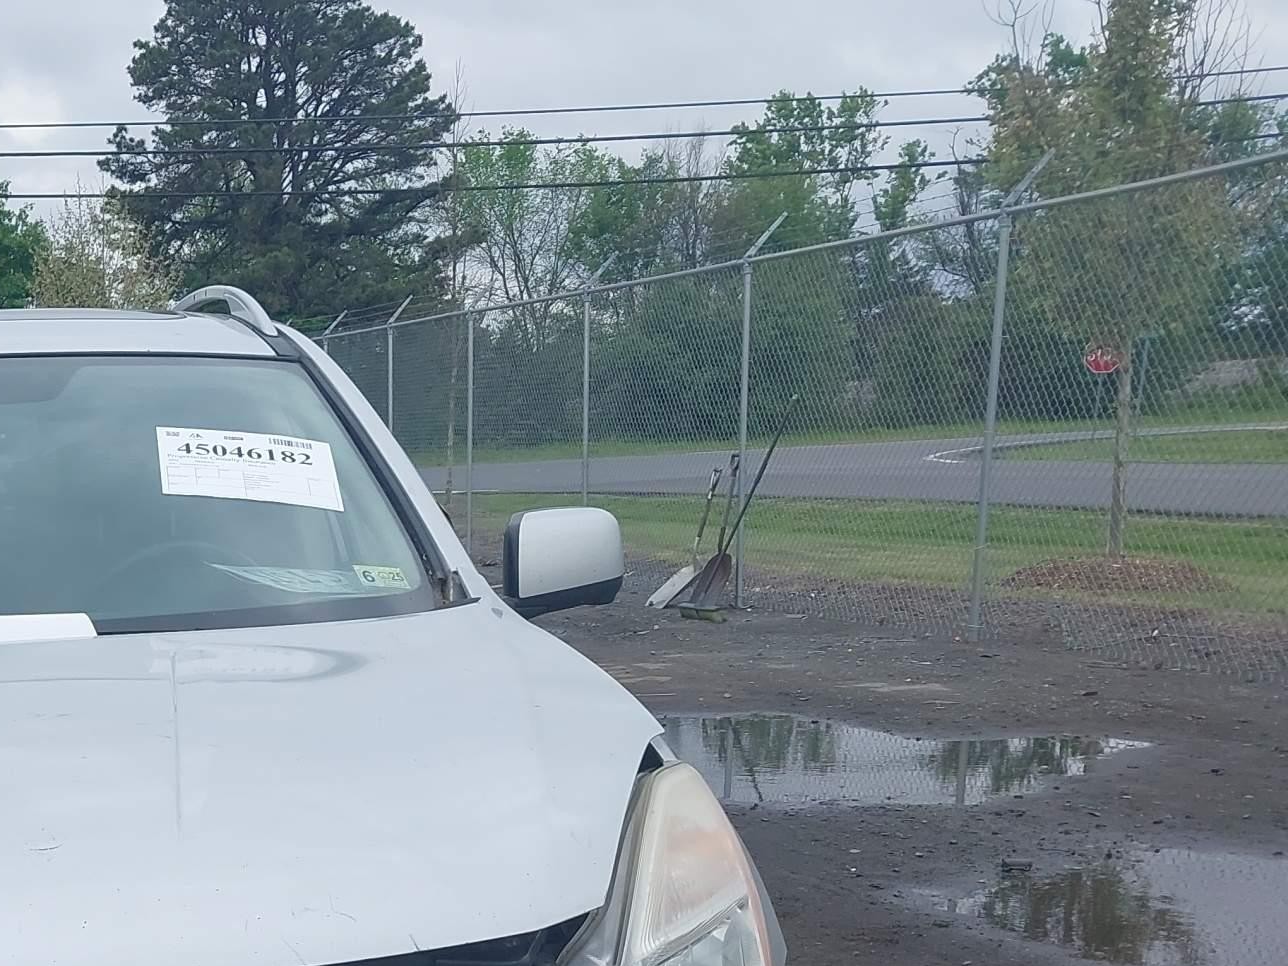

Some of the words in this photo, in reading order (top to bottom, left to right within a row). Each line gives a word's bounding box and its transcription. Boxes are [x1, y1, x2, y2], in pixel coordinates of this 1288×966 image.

[177, 442, 313, 466] 45046182
[362, 570, 375, 582] 6
[388, 571, 404, 581] 25
